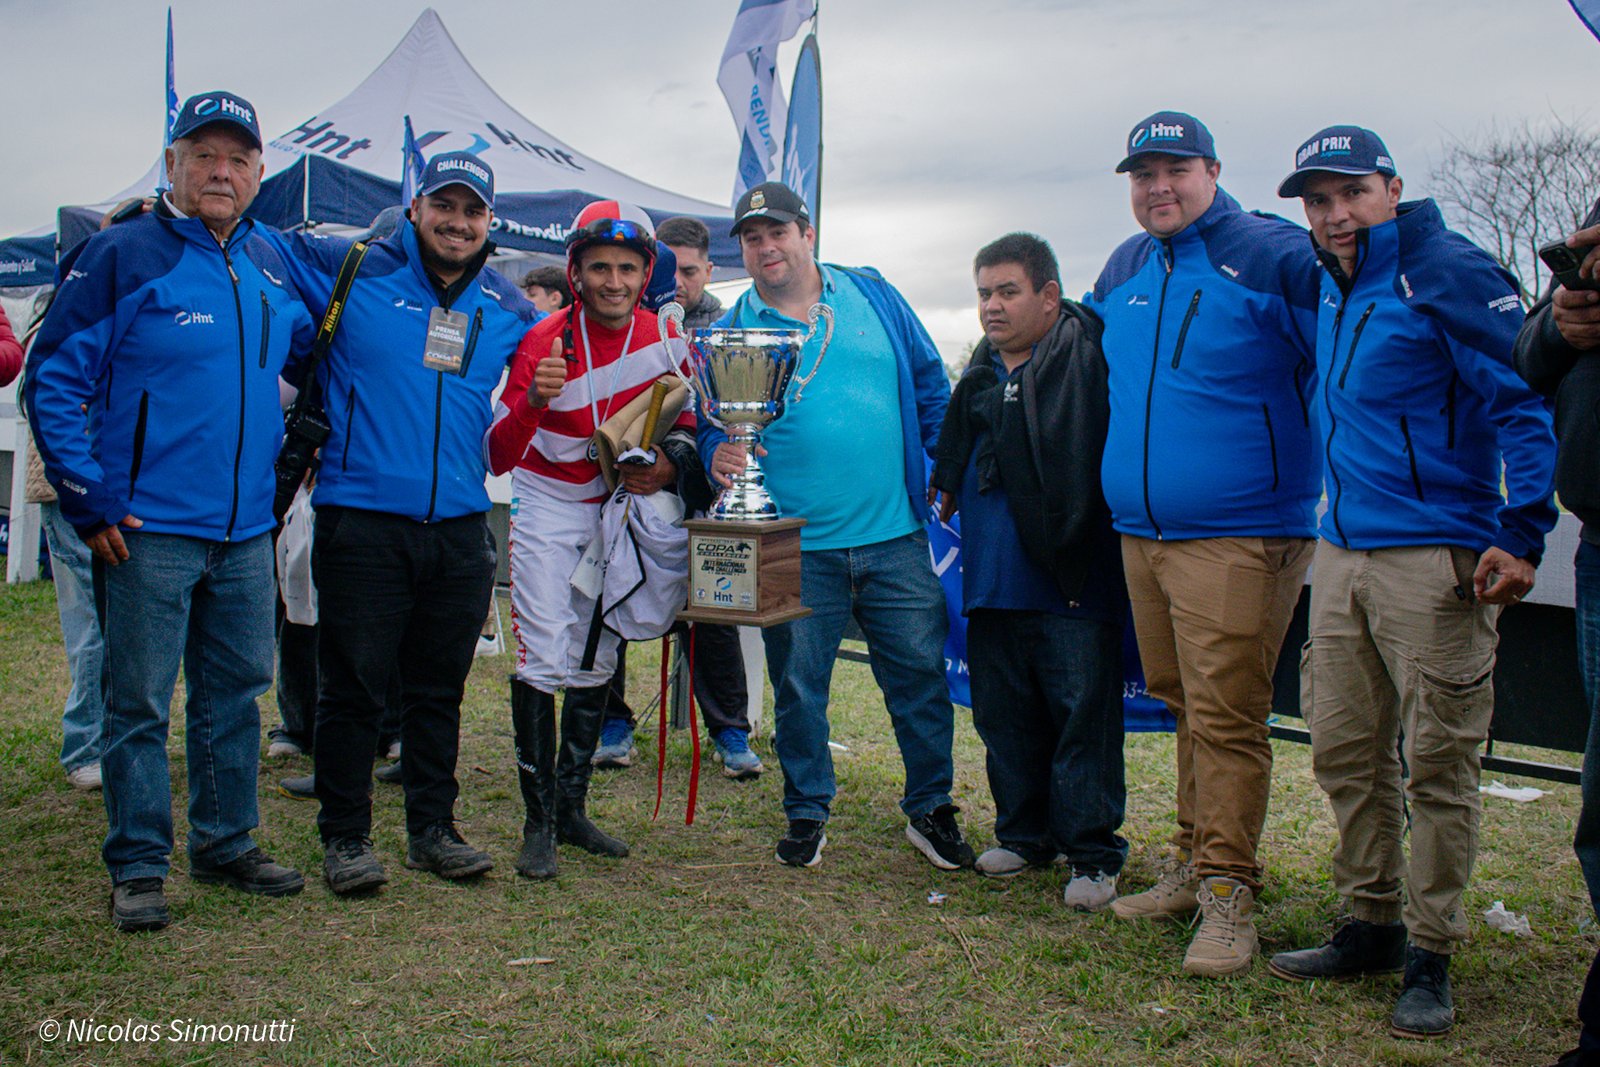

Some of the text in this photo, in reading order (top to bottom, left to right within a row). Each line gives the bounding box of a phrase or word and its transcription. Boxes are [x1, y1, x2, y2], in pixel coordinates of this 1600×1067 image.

[221, 98, 252, 123] Hnt
[1151, 123, 1184, 137] Hnt
[280, 116, 372, 159] Hnt
[1322, 136, 1352, 151] PRIX
[485, 122, 586, 171] Hnt
[437, 159, 489, 183] CHALLENGER
[192, 312, 214, 323] Hnt
[324, 300, 341, 332] Nikon
[429, 330, 465, 343] AUTORIZADA
[435, 325, 460, 336] PRENSA
[696, 543, 735, 553] COPA
[714, 591, 733, 602] Hnt
